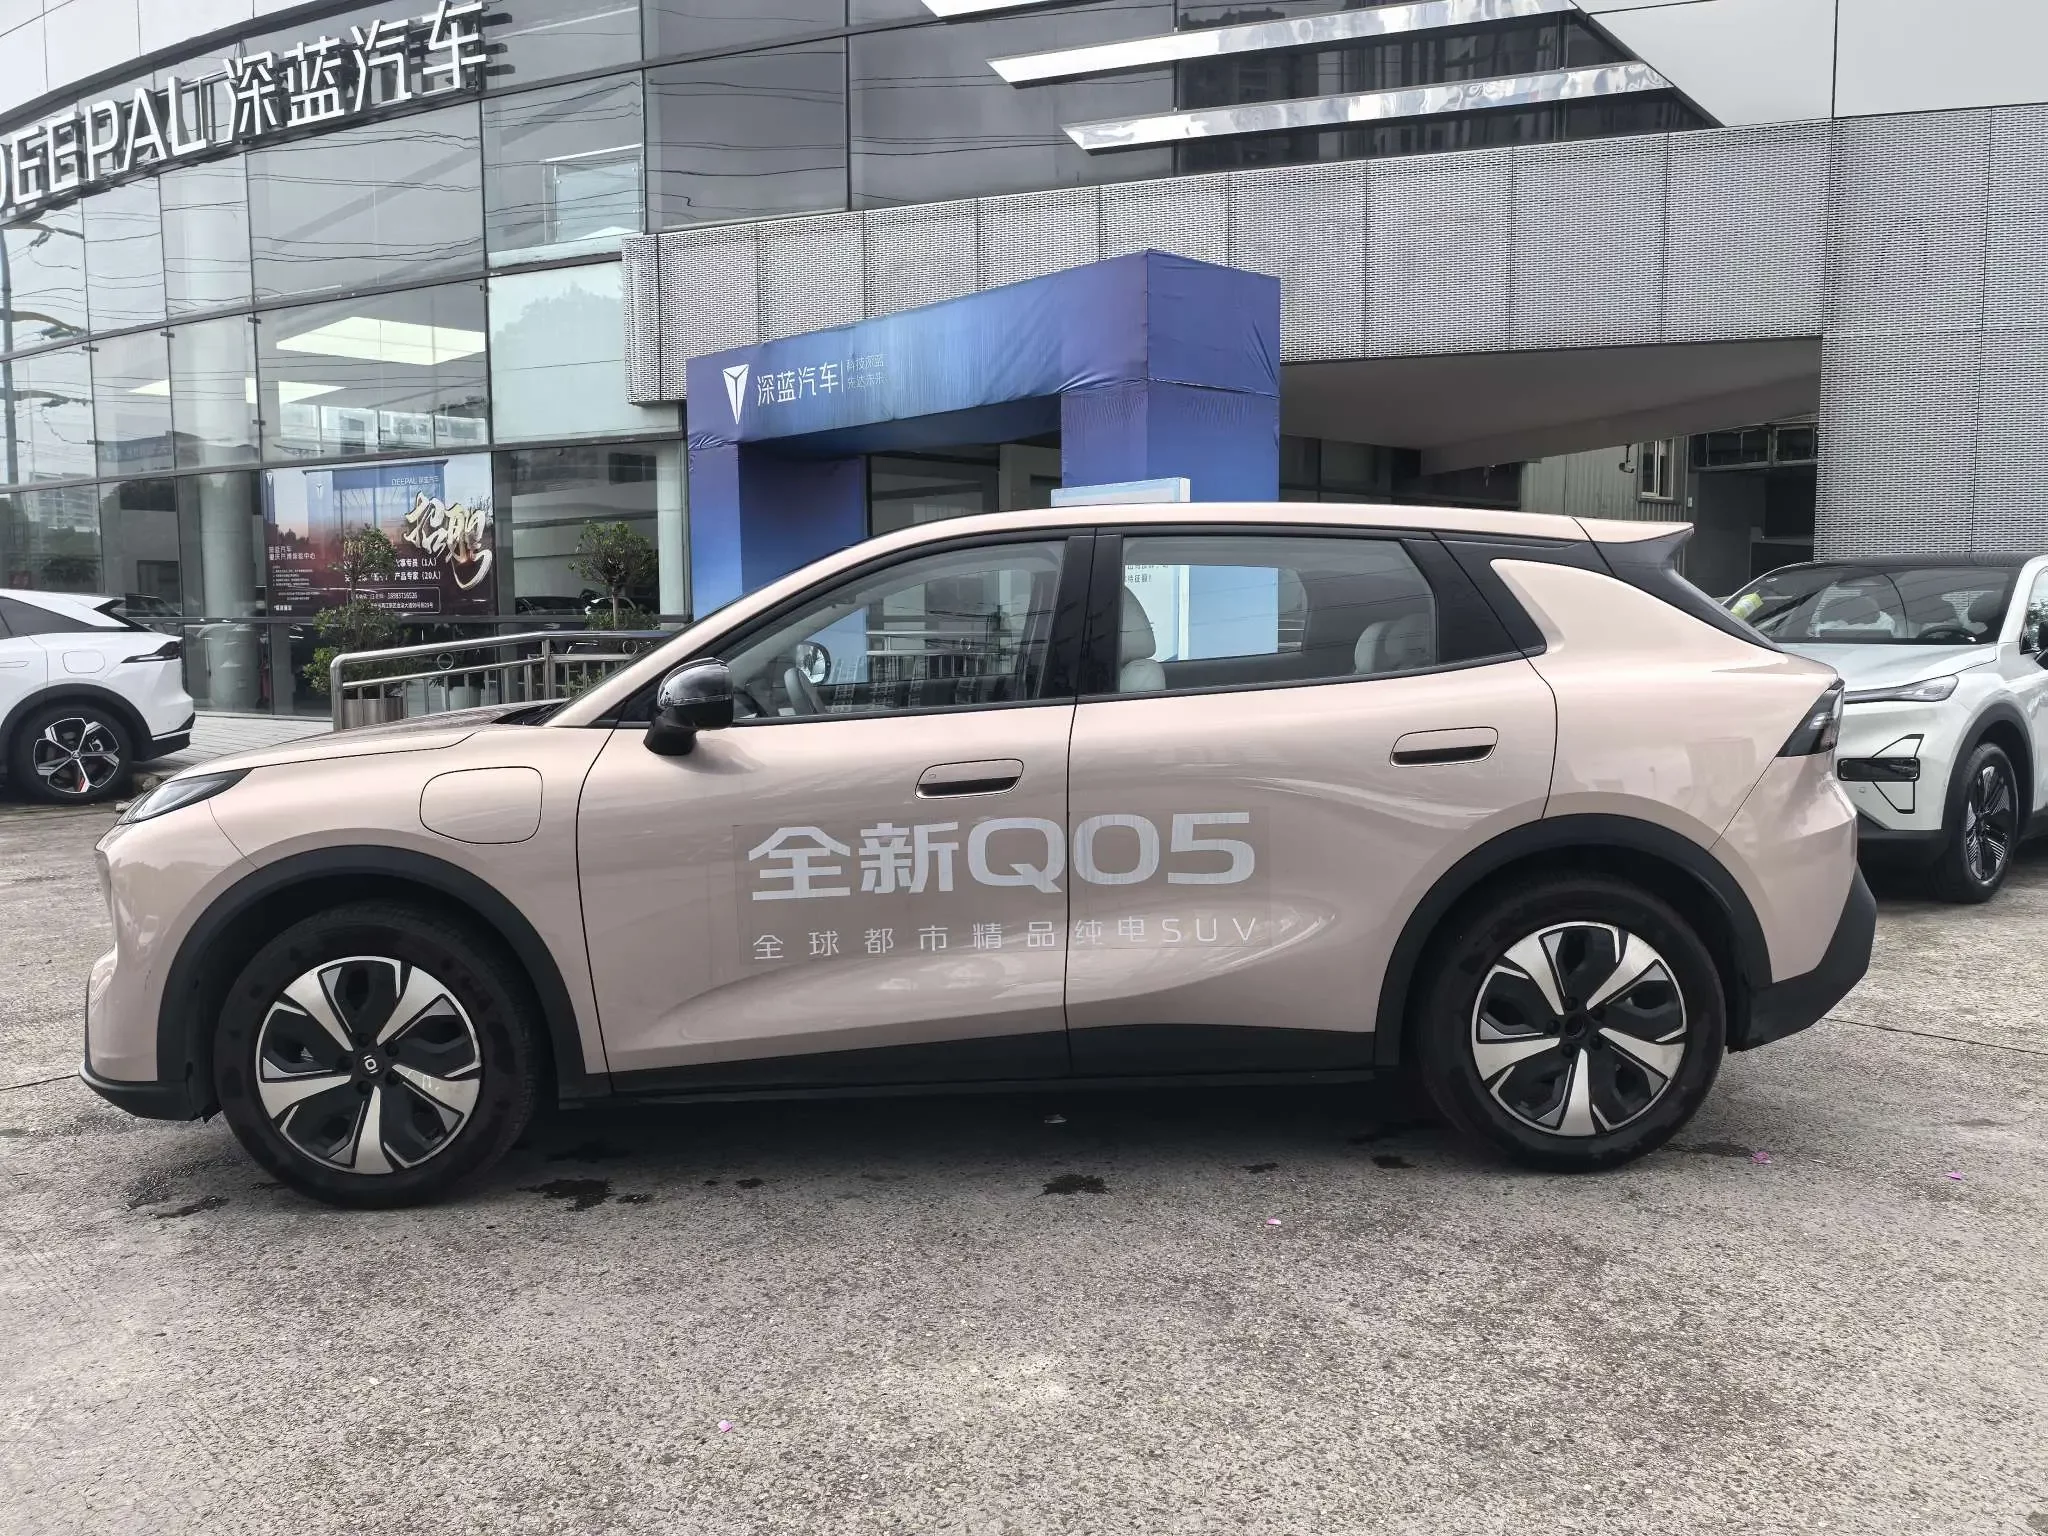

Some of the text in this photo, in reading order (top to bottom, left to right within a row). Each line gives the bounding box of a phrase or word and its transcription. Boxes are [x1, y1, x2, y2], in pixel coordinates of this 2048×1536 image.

[0, 0, 487, 208] EEPAL 深蓝汽车
[757, 361, 838, 407] 深蓝汽车
[748, 812, 1257, 901] 全新Q05
[752, 916, 1257, 961] 全球都市精品纯电SUV
